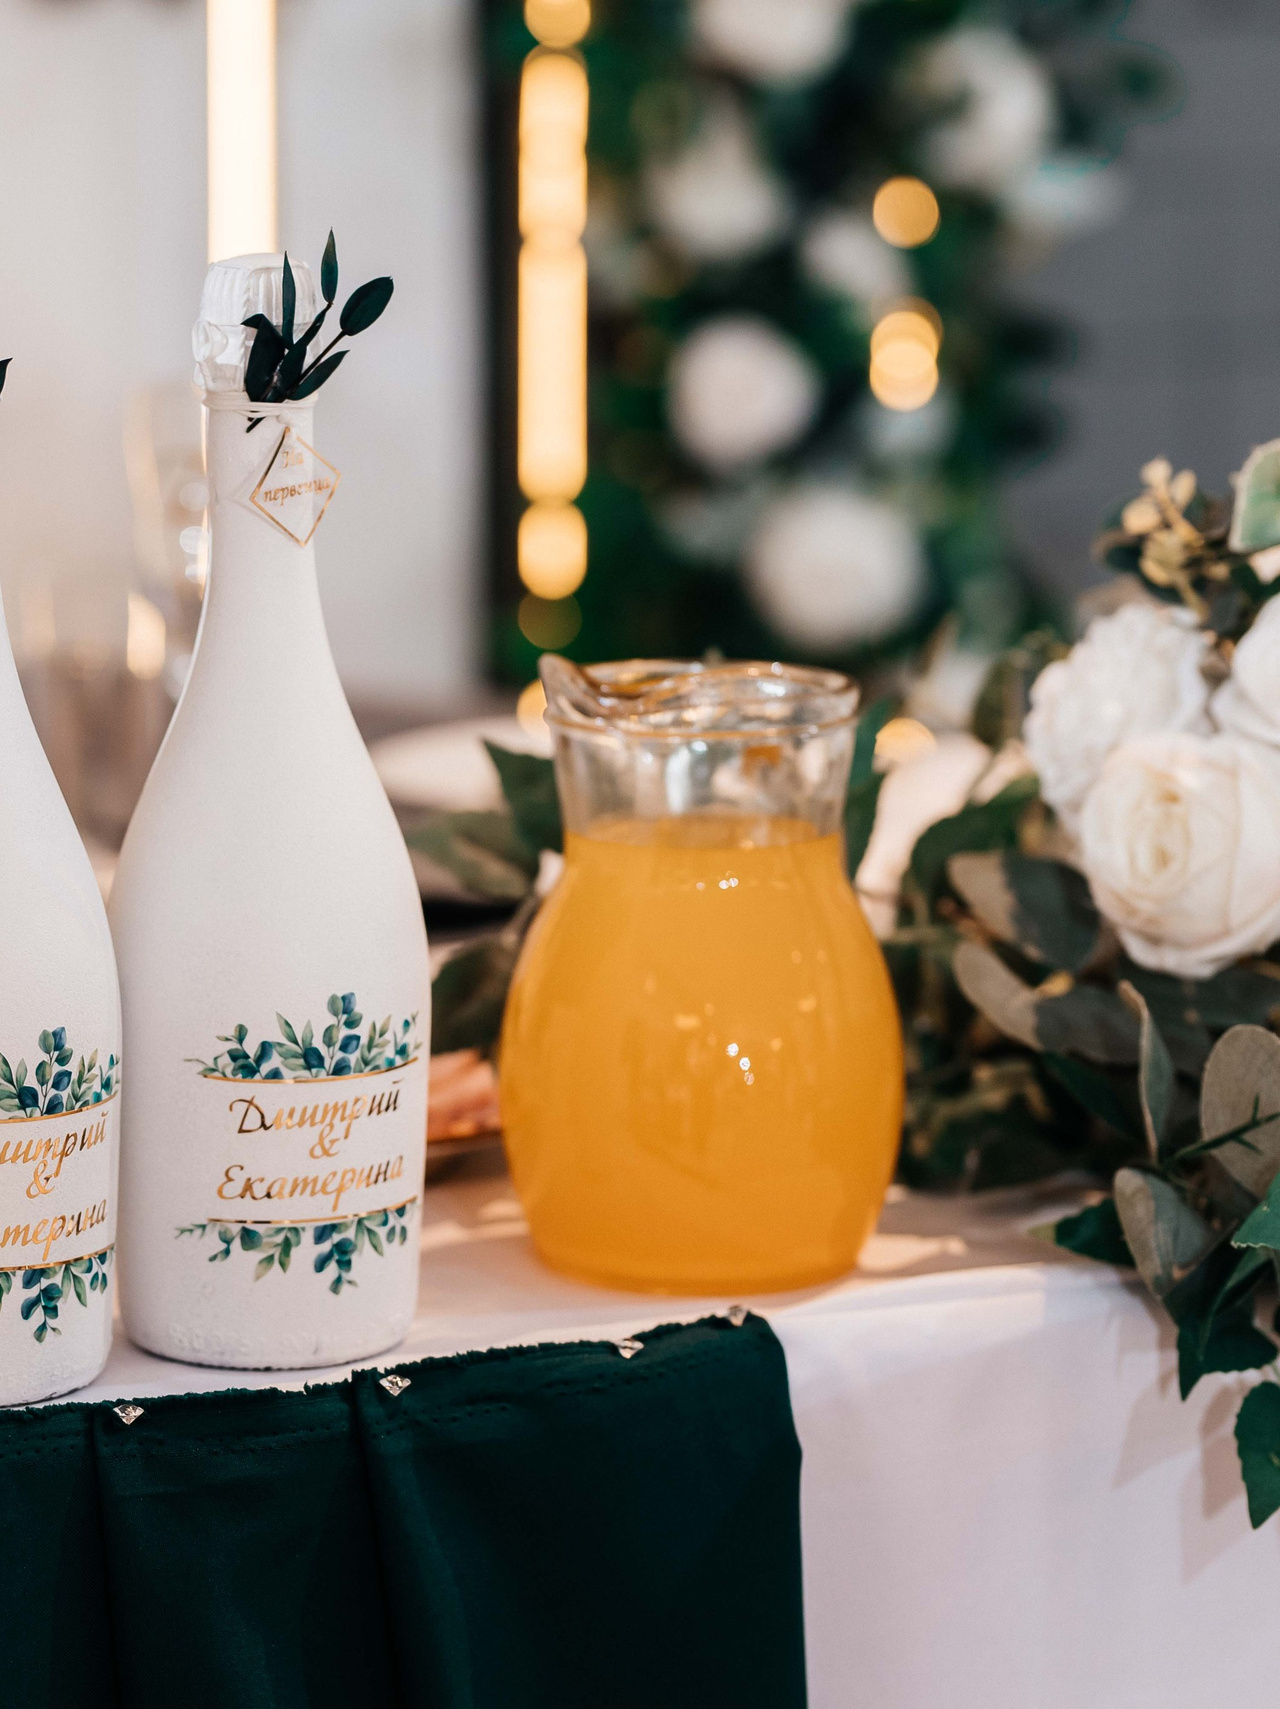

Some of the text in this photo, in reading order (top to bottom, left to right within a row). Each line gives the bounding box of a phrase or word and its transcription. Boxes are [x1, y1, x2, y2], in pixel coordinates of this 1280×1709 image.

[228, 1078, 405, 1140] Дмитрий
[309, 1122, 343, 1160] &
[25, 1159, 56, 1199] &
[217, 1154, 404, 1213] Екатерина
